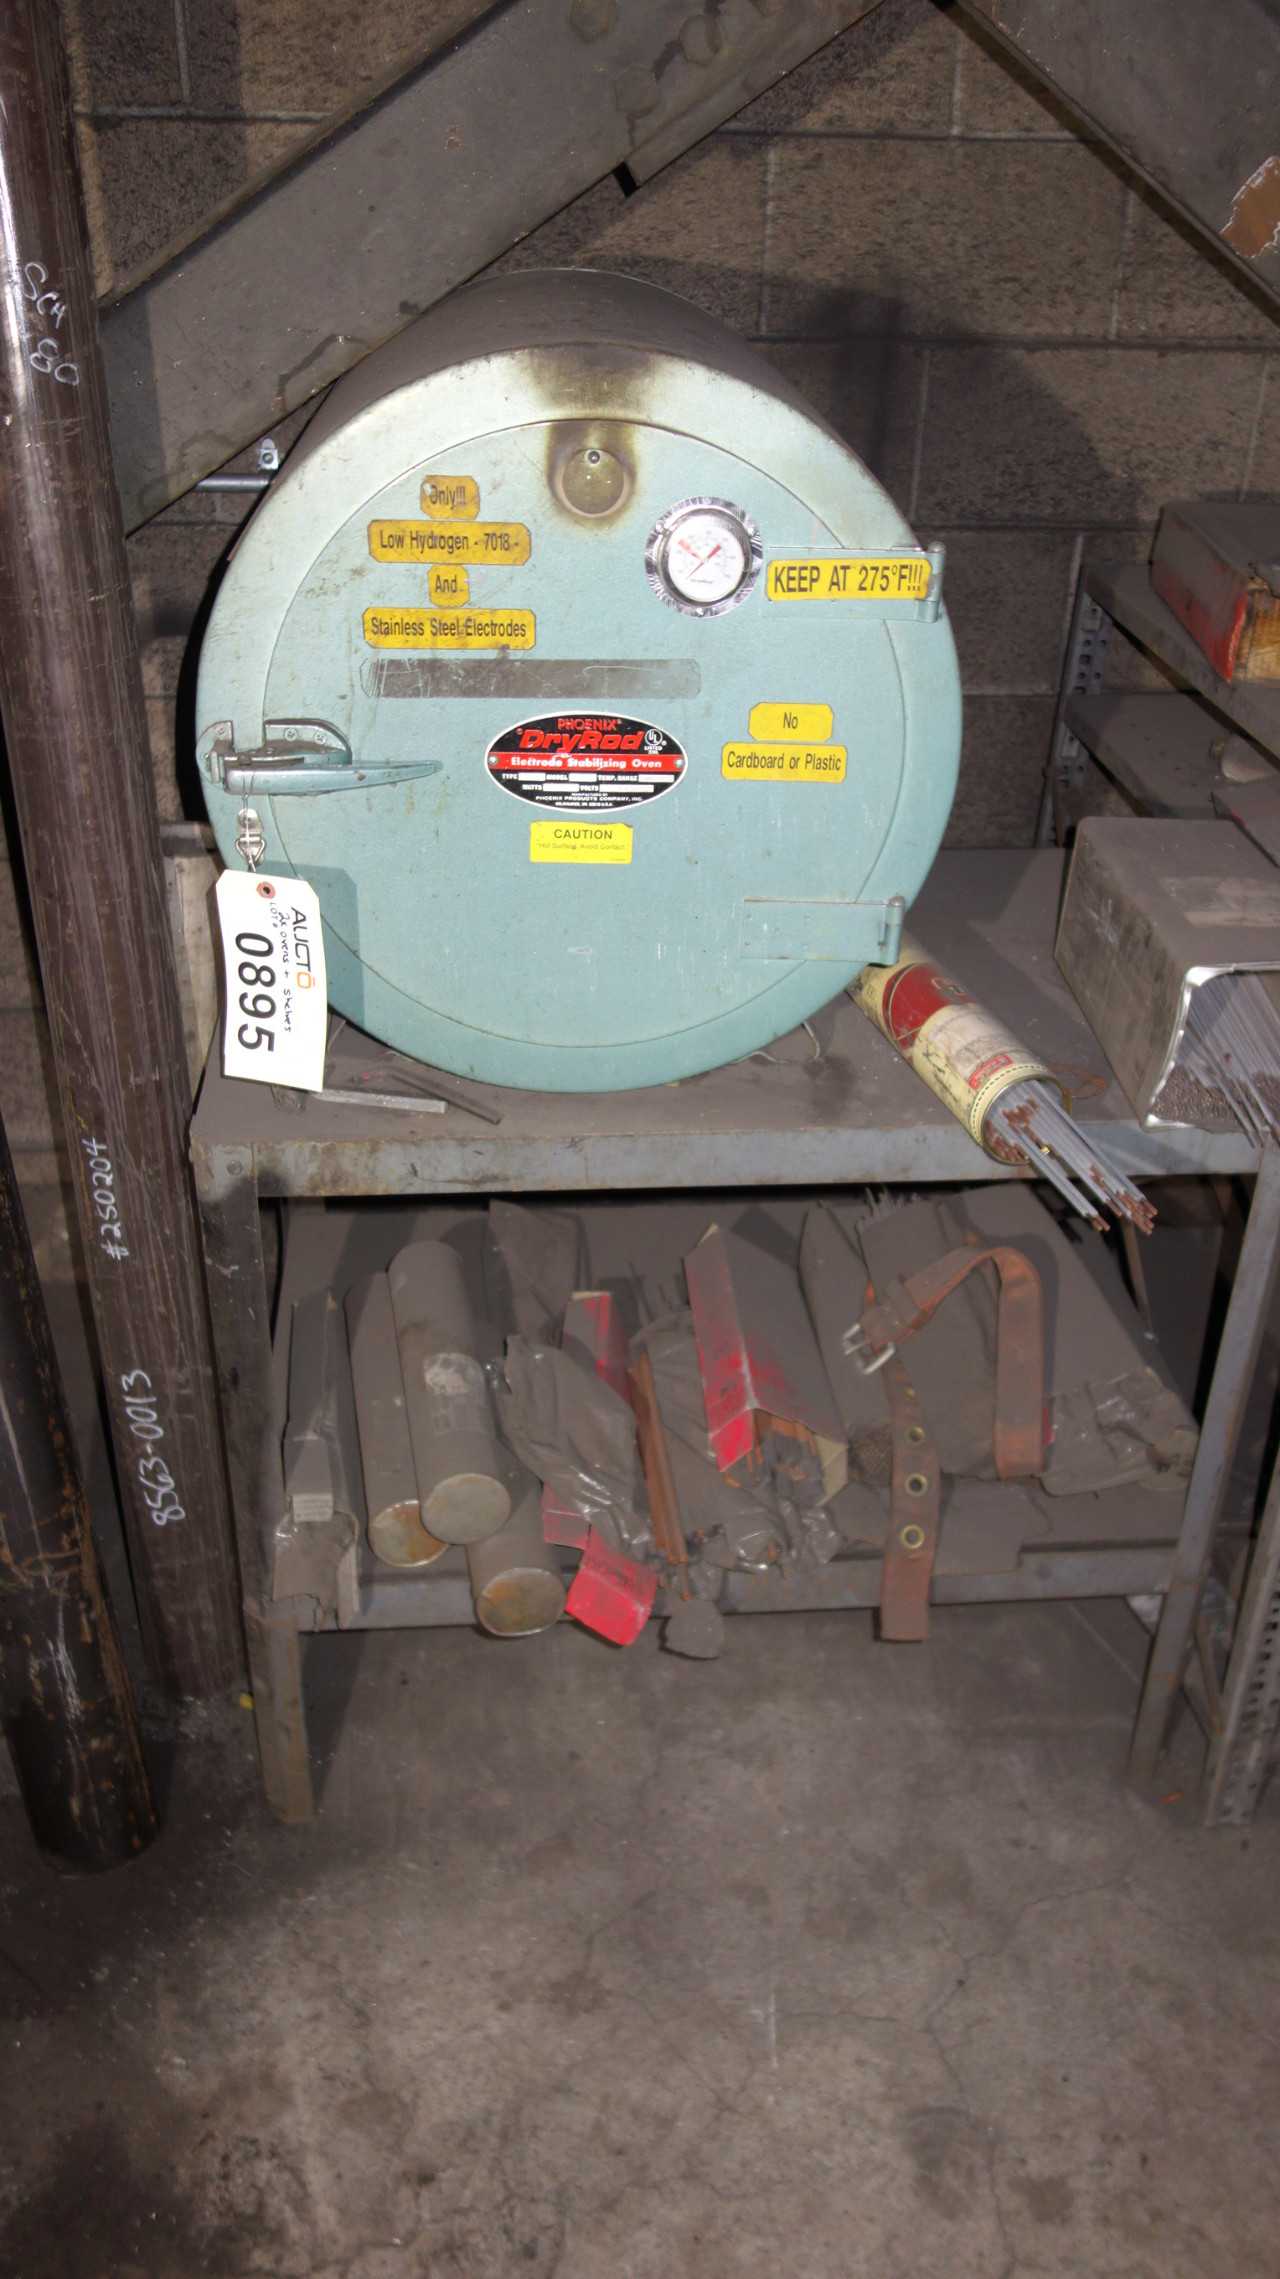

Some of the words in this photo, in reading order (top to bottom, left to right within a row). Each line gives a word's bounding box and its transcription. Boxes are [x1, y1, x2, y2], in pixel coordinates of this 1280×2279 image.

[380, 531, 405, 549] Low
[409, 531, 469, 554] Hydrogen
[484, 533, 510, 551] 7018
[435, 574, 458, 593] And
[774, 565, 820, 593] KEEP
[828, 564, 851, 592] AT
[371, 617, 425, 637] Stainless
[430, 618, 460, 637] Steel
[464, 619, 526, 638] Electrodes
[783, 711, 799, 730] No
[518, 729, 644, 754] DryRod
[511, 756, 562, 768] Electrode
[567, 757, 627, 769] Stabilizing
[631, 758, 662, 769] Oven
[727, 750, 785, 770] Cardboard
[788, 757, 801, 770] or
[804, 753, 842, 772] Plastic
[553, 828, 613, 840] CAUTION
[235, 931, 277, 1053] 0895
[82, 1136, 129, 1261] #250204
